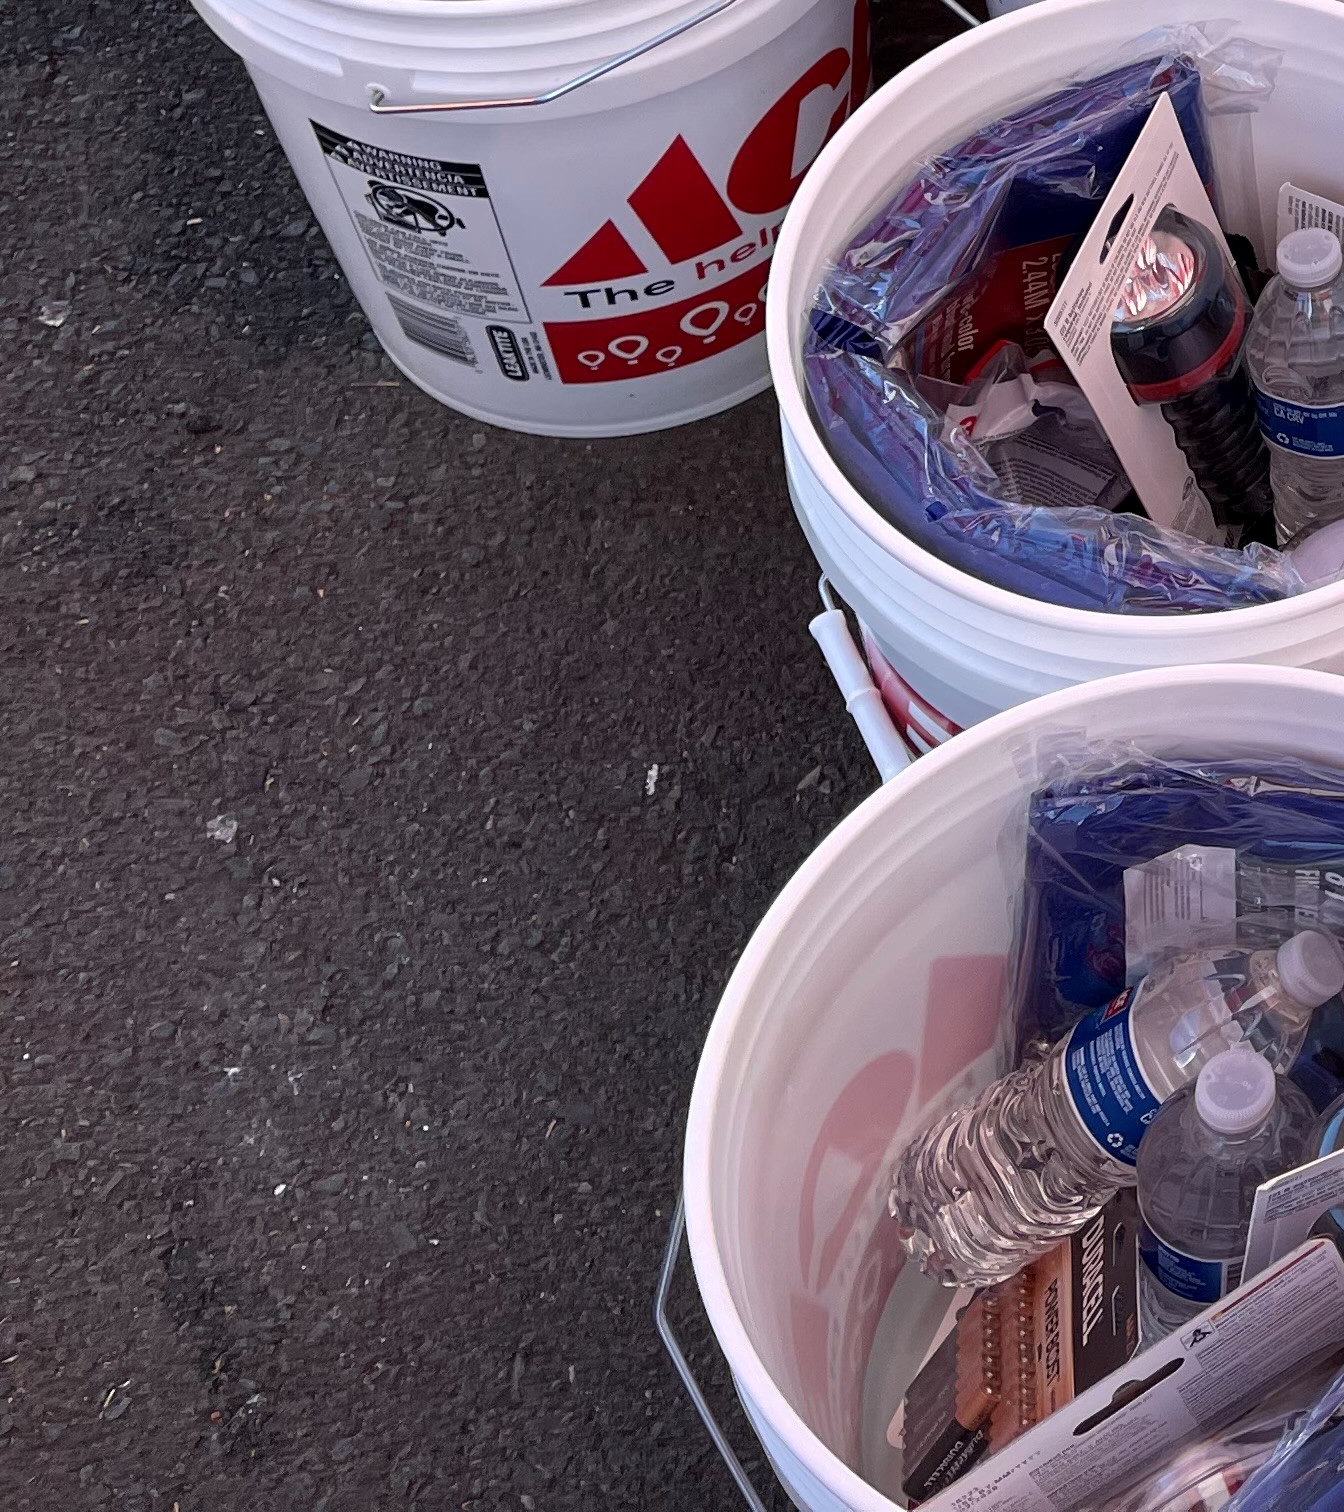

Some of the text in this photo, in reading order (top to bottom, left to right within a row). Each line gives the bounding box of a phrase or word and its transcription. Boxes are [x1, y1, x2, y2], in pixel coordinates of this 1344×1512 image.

[361, 143, 443, 171] WARNING
[563, 278, 676, 309] The
[1081, 1214, 1105, 1348] DURACELL
[922, 1437, 965, 1490] DURACELL
